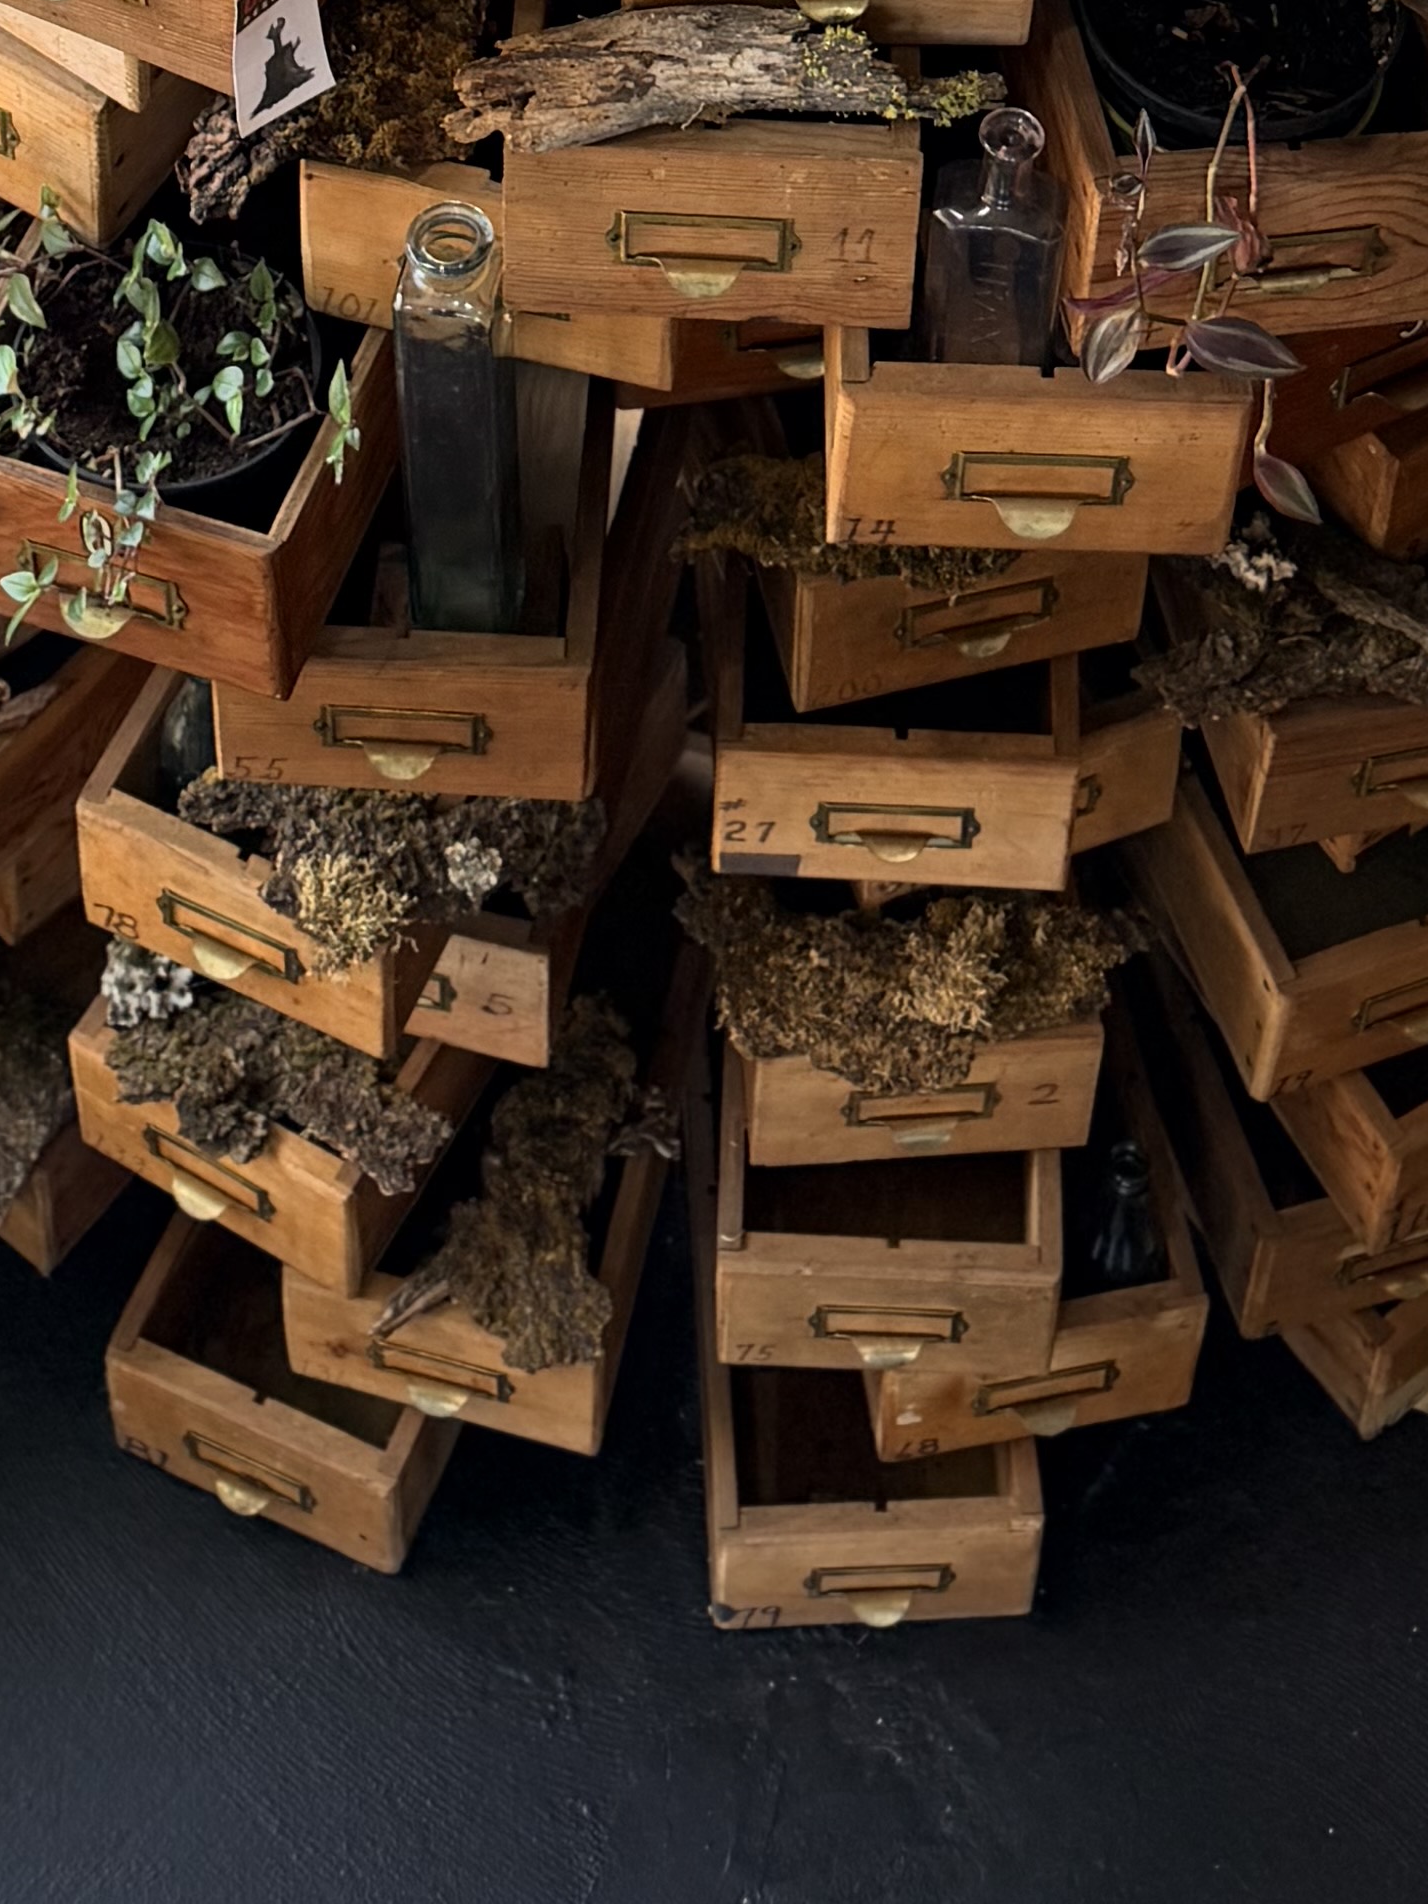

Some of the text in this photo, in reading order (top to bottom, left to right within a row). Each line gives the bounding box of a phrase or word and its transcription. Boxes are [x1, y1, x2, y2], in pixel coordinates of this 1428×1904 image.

[828, 226, 877, 264] 11
[322, 285, 381, 322] 101
[232, 756, 290, 782] 55
[723, 820, 777, 844] 27
[93, 903, 141, 939] 78
[480, 991, 517, 1016] 5
[1028, 1084, 1059, 1106] 2
[735, 1344, 775, 1362] 75
